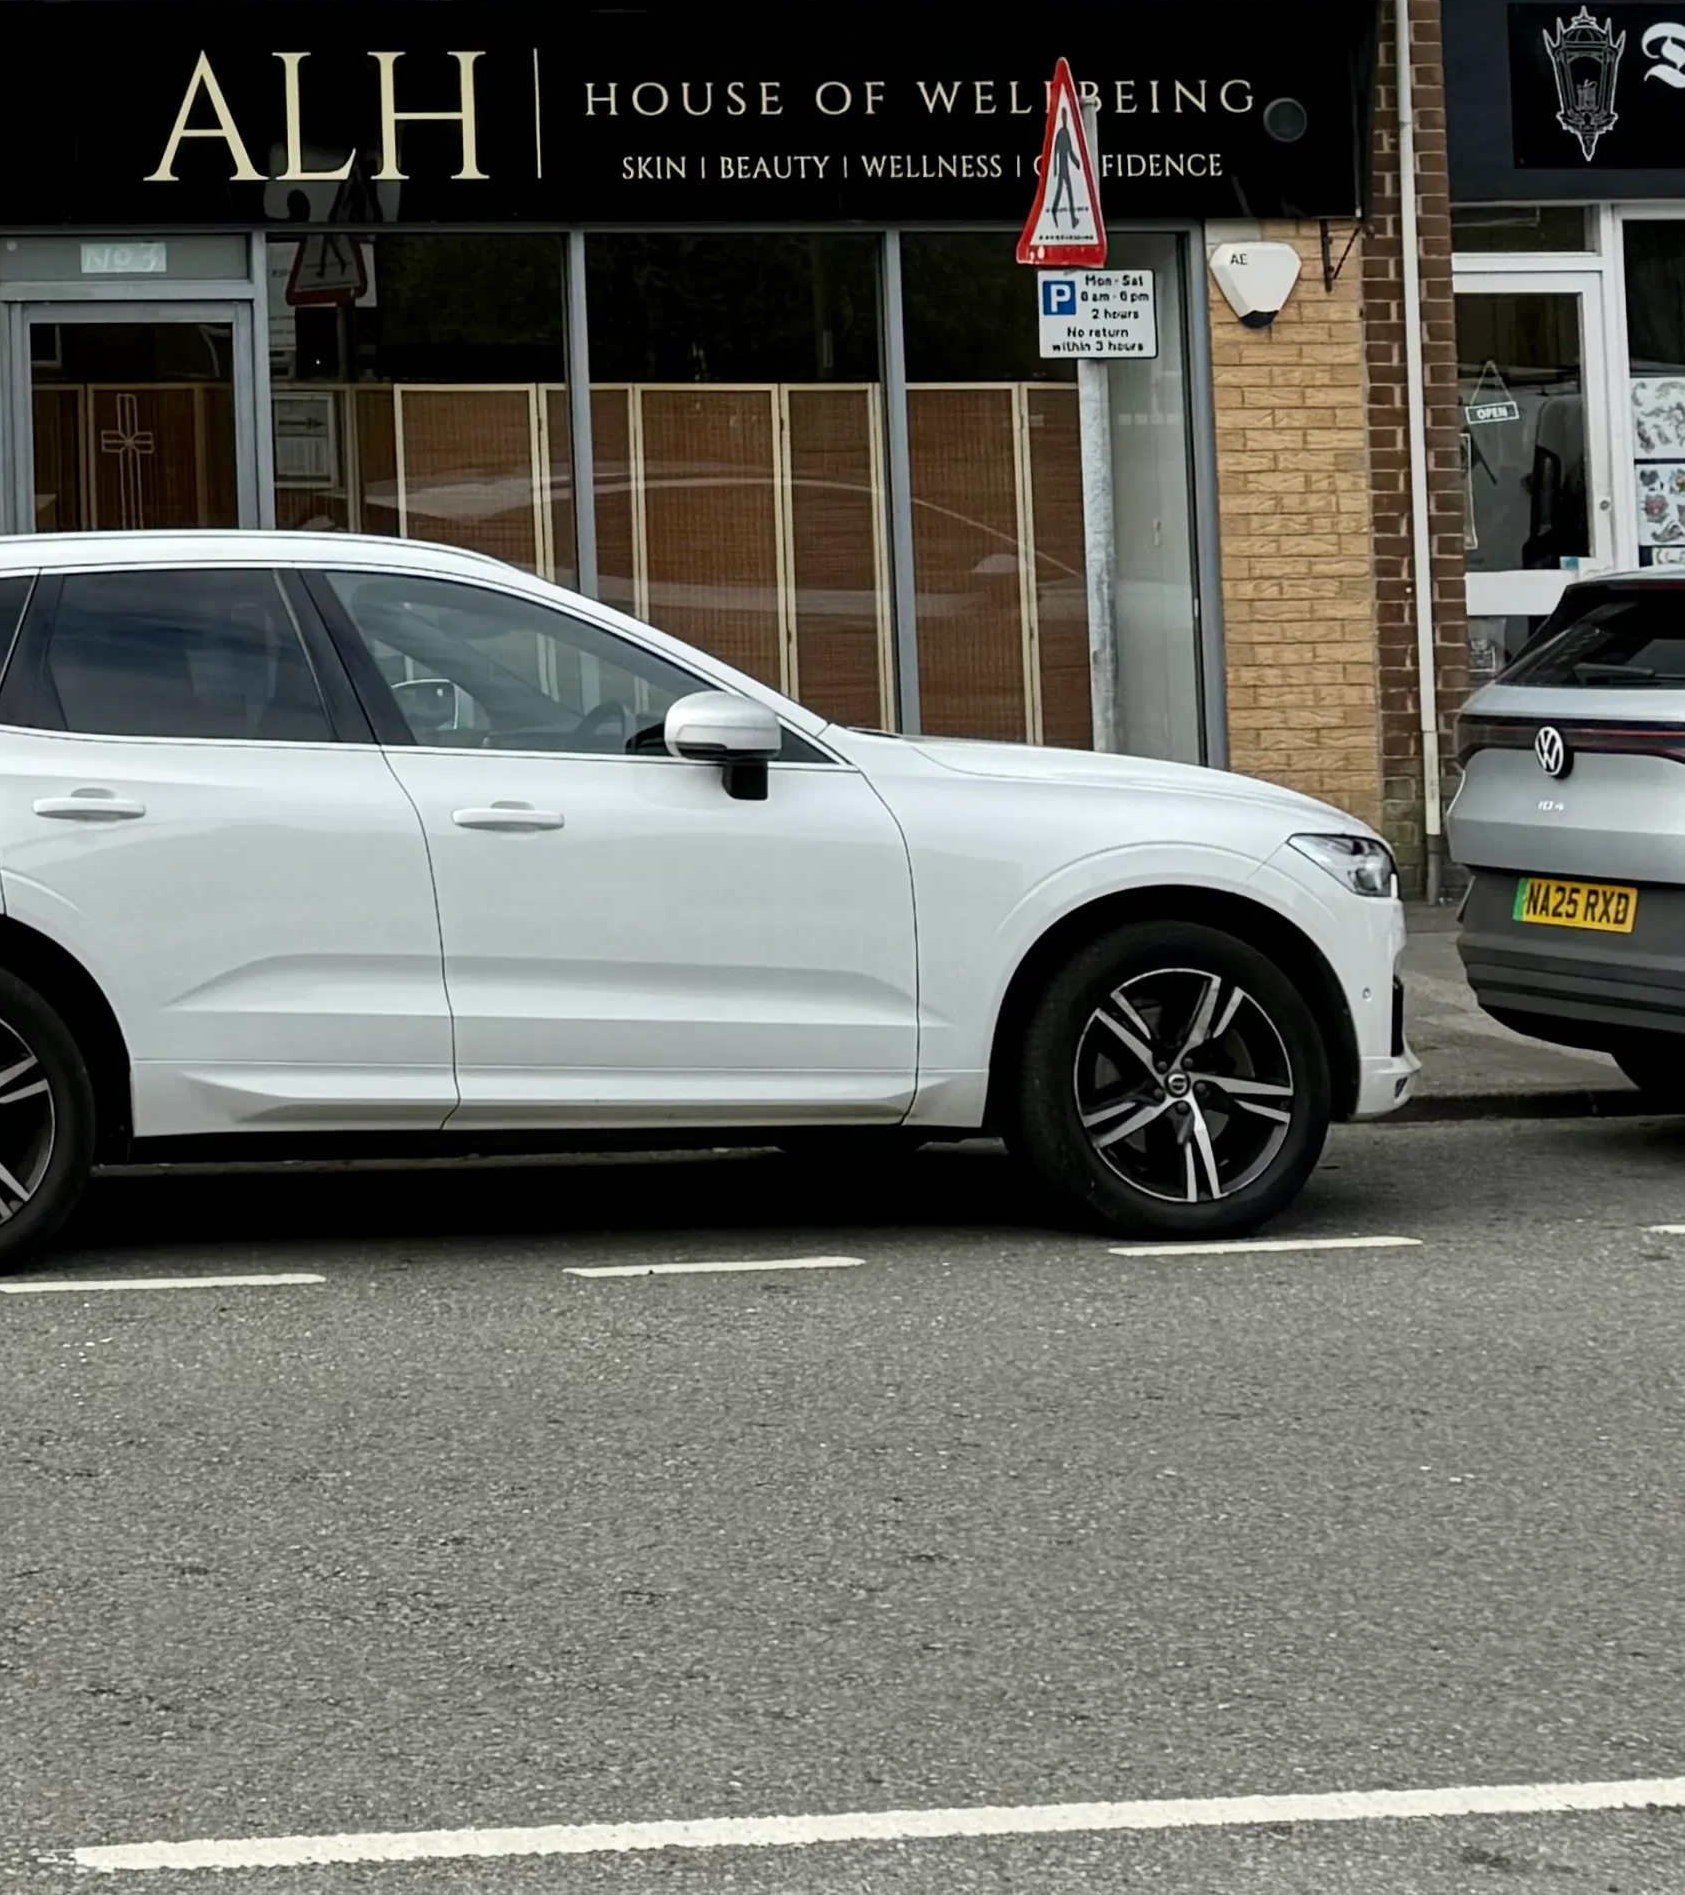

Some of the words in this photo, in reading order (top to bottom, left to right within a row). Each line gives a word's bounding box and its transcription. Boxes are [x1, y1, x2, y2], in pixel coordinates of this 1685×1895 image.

[585, 81, 783, 116] HOUSE
[815, 81, 885, 116] OF
[142, 49, 490, 182] ALH
[622, 155, 686, 180] SKIN
[720, 155, 830, 179] BEAUTY
[860, 154, 1003, 179] WELLNESS
[1033, 154, 1224, 179] FIDENCE
[1085, 274, 1112, 287] Mon
[1050, 284, 1071, 313] P
[1130, 292, 1150, 304] pm
[1091, 308, 1100, 320] 2
[1104, 309, 1139, 320] hours
[1067, 326, 1085, 338] No
[1089, 327, 1129, 338] return
[1476, 407, 1509, 420] OPEN
[1525, 880, 1581, 920] NA25
[1583, 888, 1630, 925] RXD
